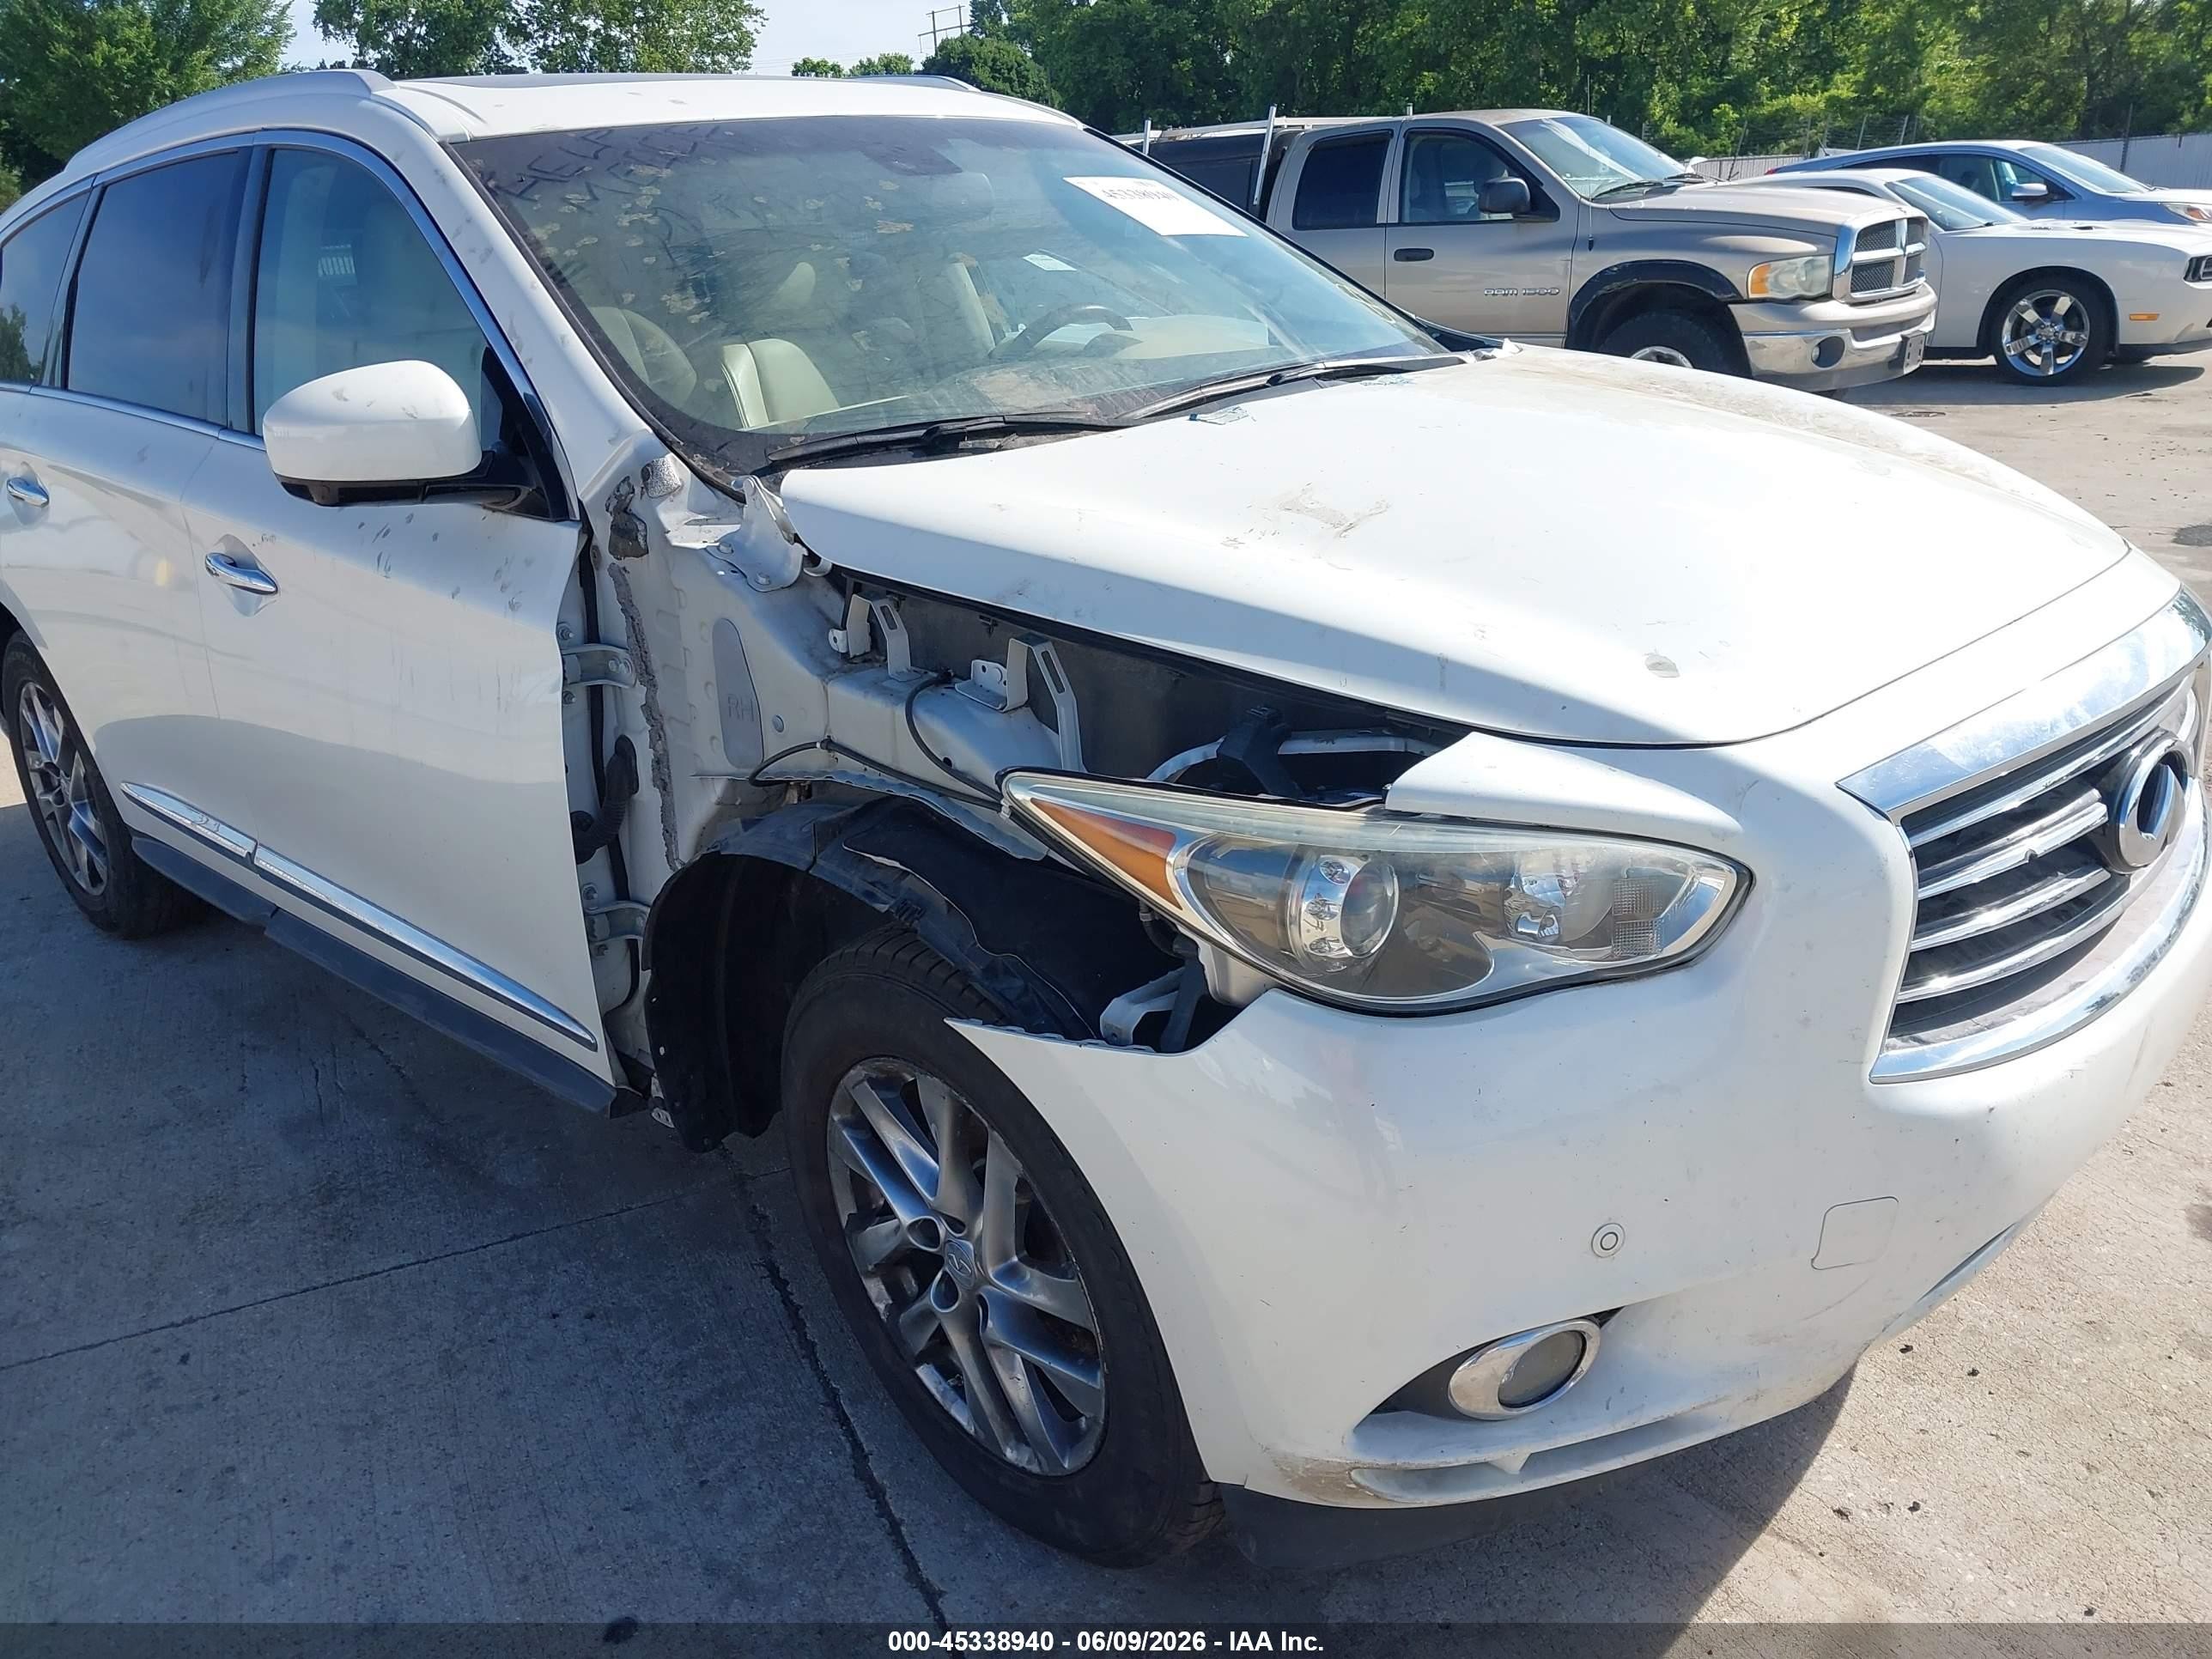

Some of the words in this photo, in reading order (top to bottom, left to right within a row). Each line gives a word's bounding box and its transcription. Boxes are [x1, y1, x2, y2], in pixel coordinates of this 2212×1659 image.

[1483, 288, 1518, 297] RAM
[1522, 287, 1560, 296] 1500
[727, 694, 755, 722] RH
